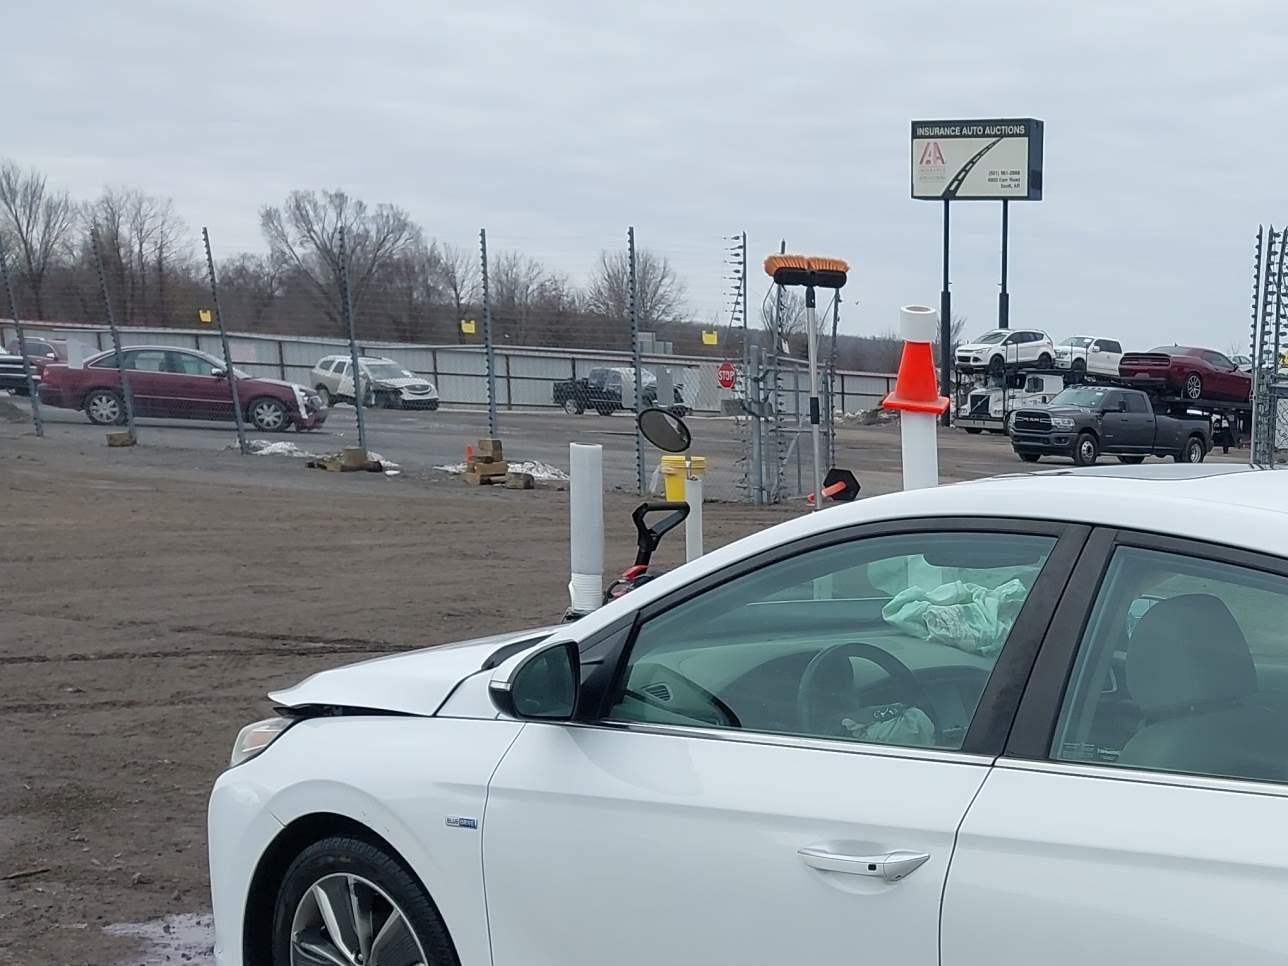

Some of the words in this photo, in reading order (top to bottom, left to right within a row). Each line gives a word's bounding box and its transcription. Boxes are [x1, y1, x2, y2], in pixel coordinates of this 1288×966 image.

[917, 126, 960, 136] INSURANCE
[962, 126, 983, 136] AUTO
[985, 125, 1025, 135] AUCTIONS
[719, 370, 735, 381] STOP
